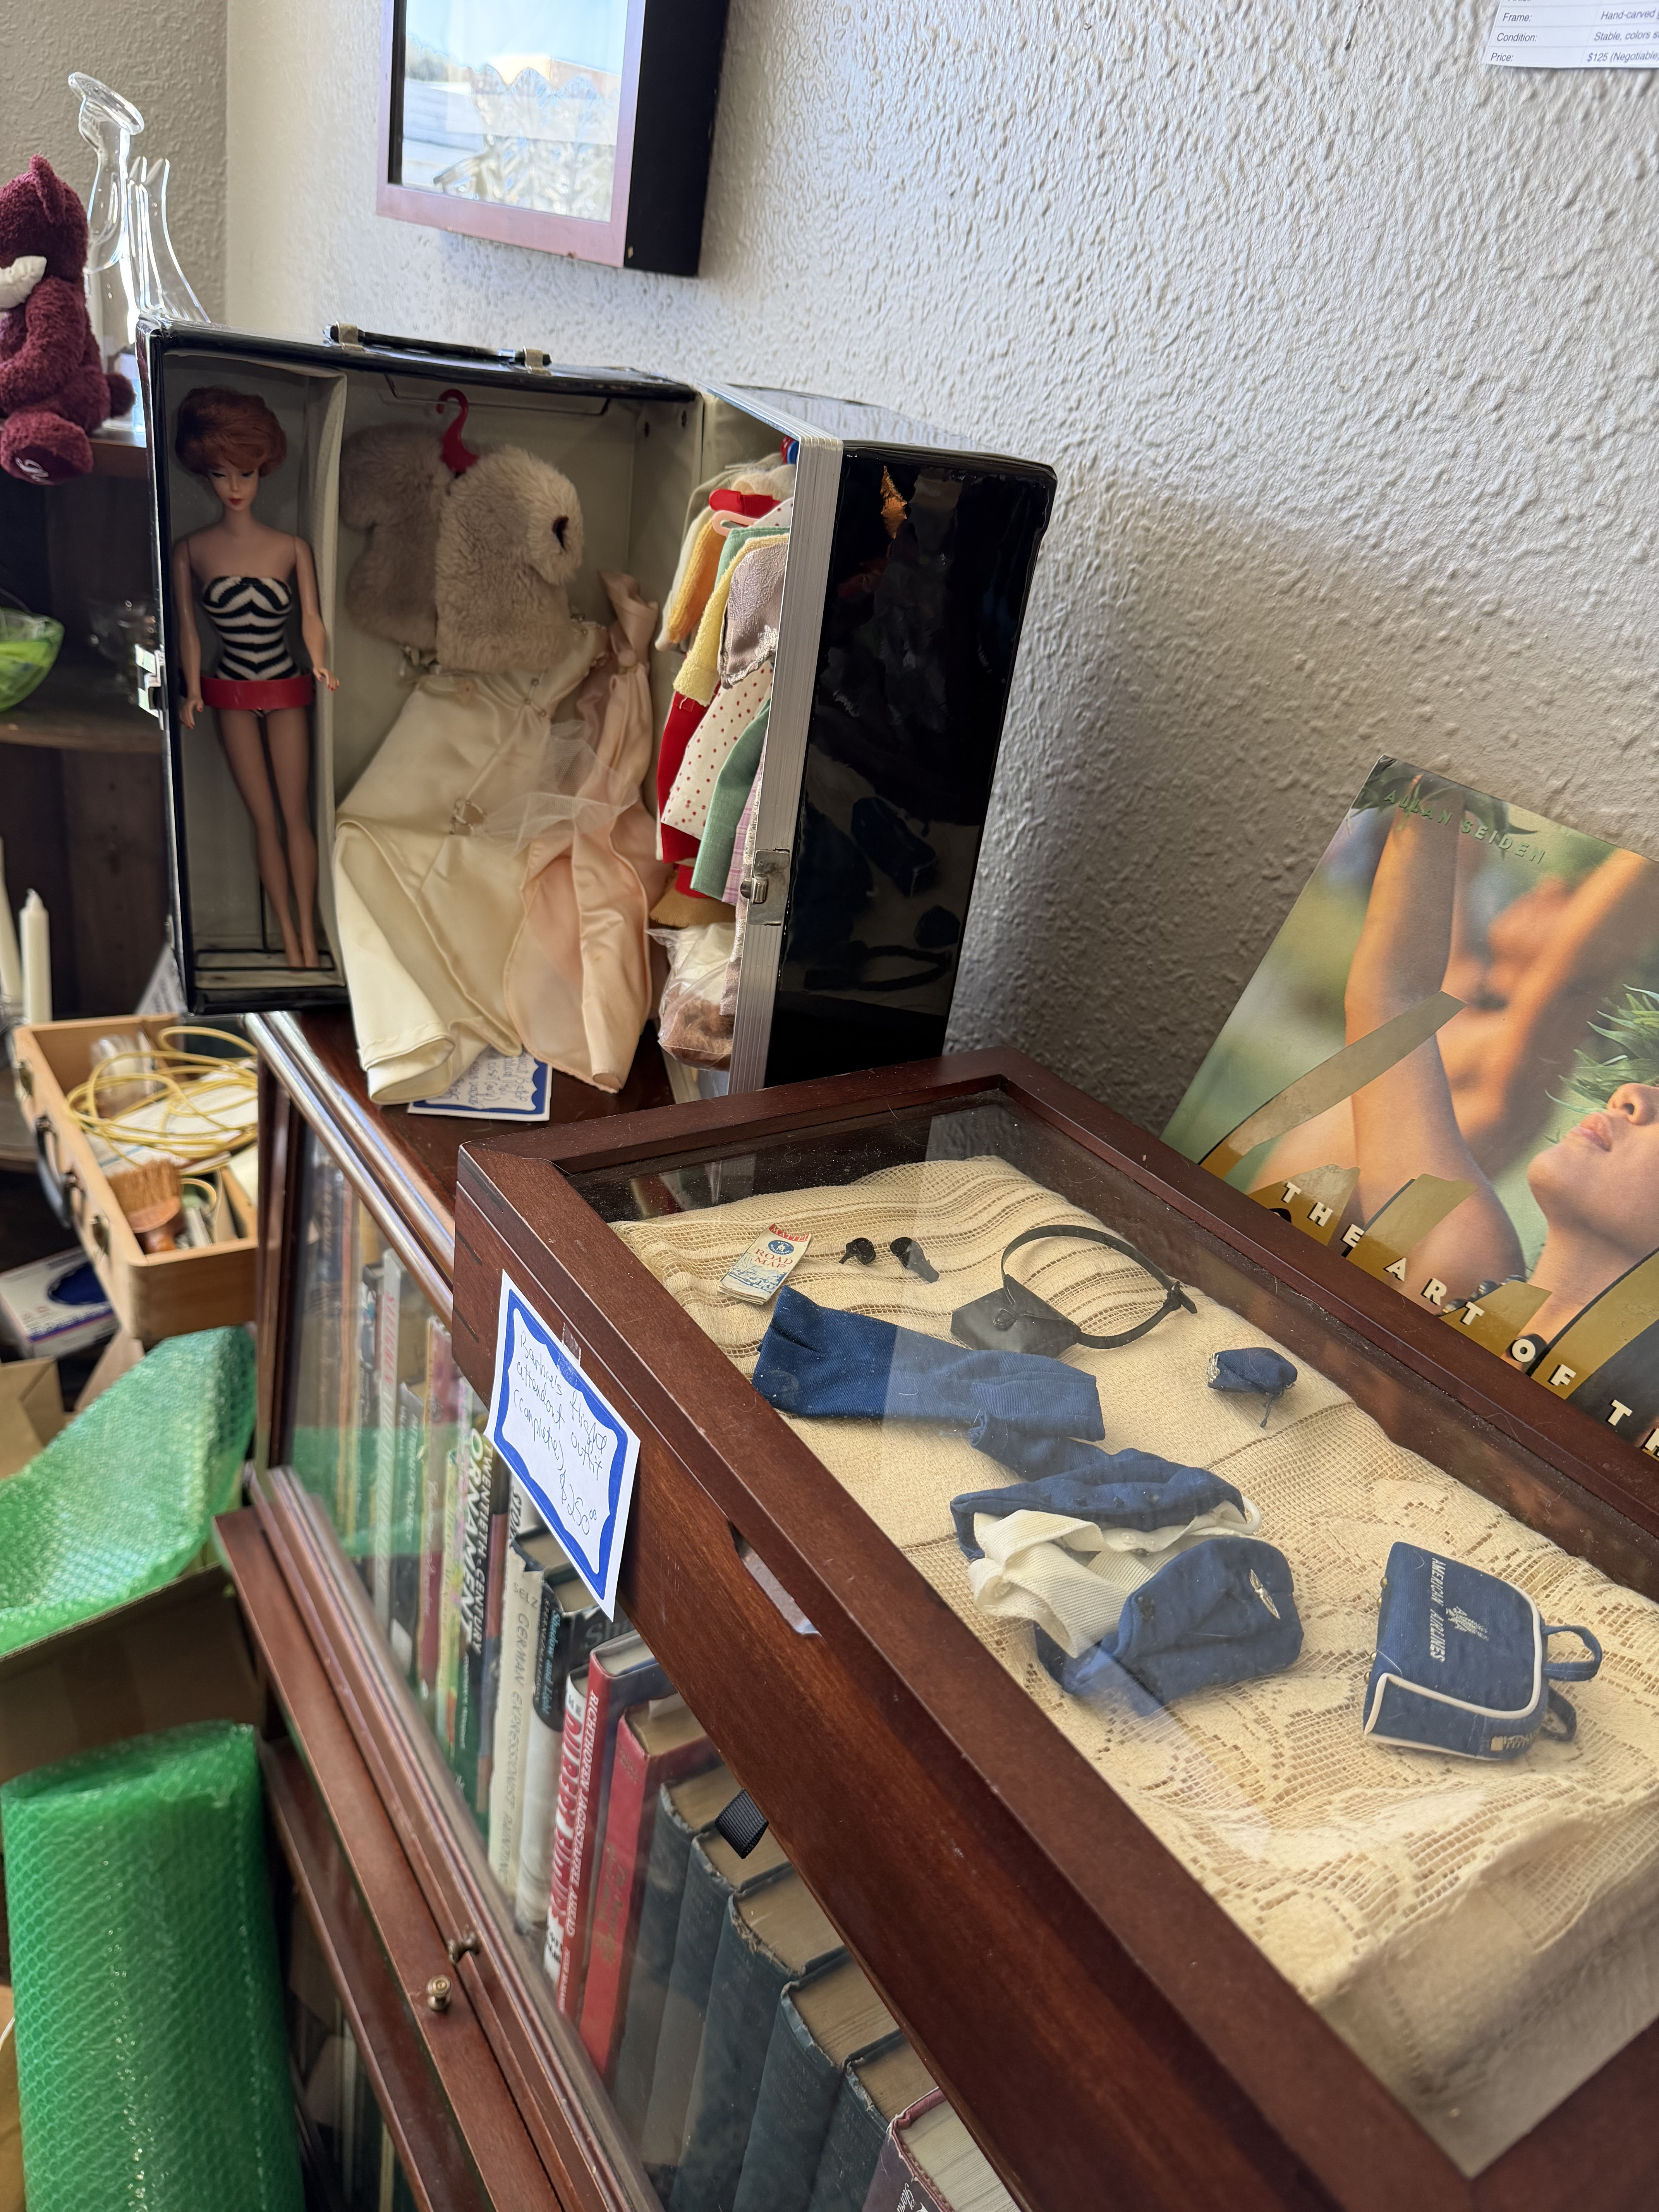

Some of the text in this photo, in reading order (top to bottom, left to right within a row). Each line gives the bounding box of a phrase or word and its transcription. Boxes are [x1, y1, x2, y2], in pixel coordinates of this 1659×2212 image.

[1503, 12, 1532, 22] Frame:
[1600, 9, 1656, 21] Hand-carved
[1496, 33, 1538, 42] Condition:
[1594, 31, 1622, 41] Stable,
[1625, 30, 1650, 40] colors
[1490, 53, 1514, 62] Price:
[1587, 52, 1608, 62] $125
[1383, 790, 1546, 864] ALLAN SEIDEN
[771, 1224, 808, 1242] MATTEL
[754, 1256, 786, 1268] MAP
[755, 1248, 793, 1264] ROAD
[1281, 1182, 1365, 1248] THE
[1383, 1257, 1485, 1326] ART
[1510, 1338, 1577, 1386] OF
[460, 1427, 483, 1645] ORNAMENT
[513, 1582, 539, 1609] SELZ
[1429, 1557, 1446, 1663] AMERICAN AIRLINES
[514, 1613, 530, 1686] GERMAN
[541, 1609, 561, 1716] Shadow and Light
[506, 1690, 522, 1810] EXPRESSIONIST
[566, 1689, 599, 1938] RICHTHOFEN JAGDSTAFFEL AHEAD
